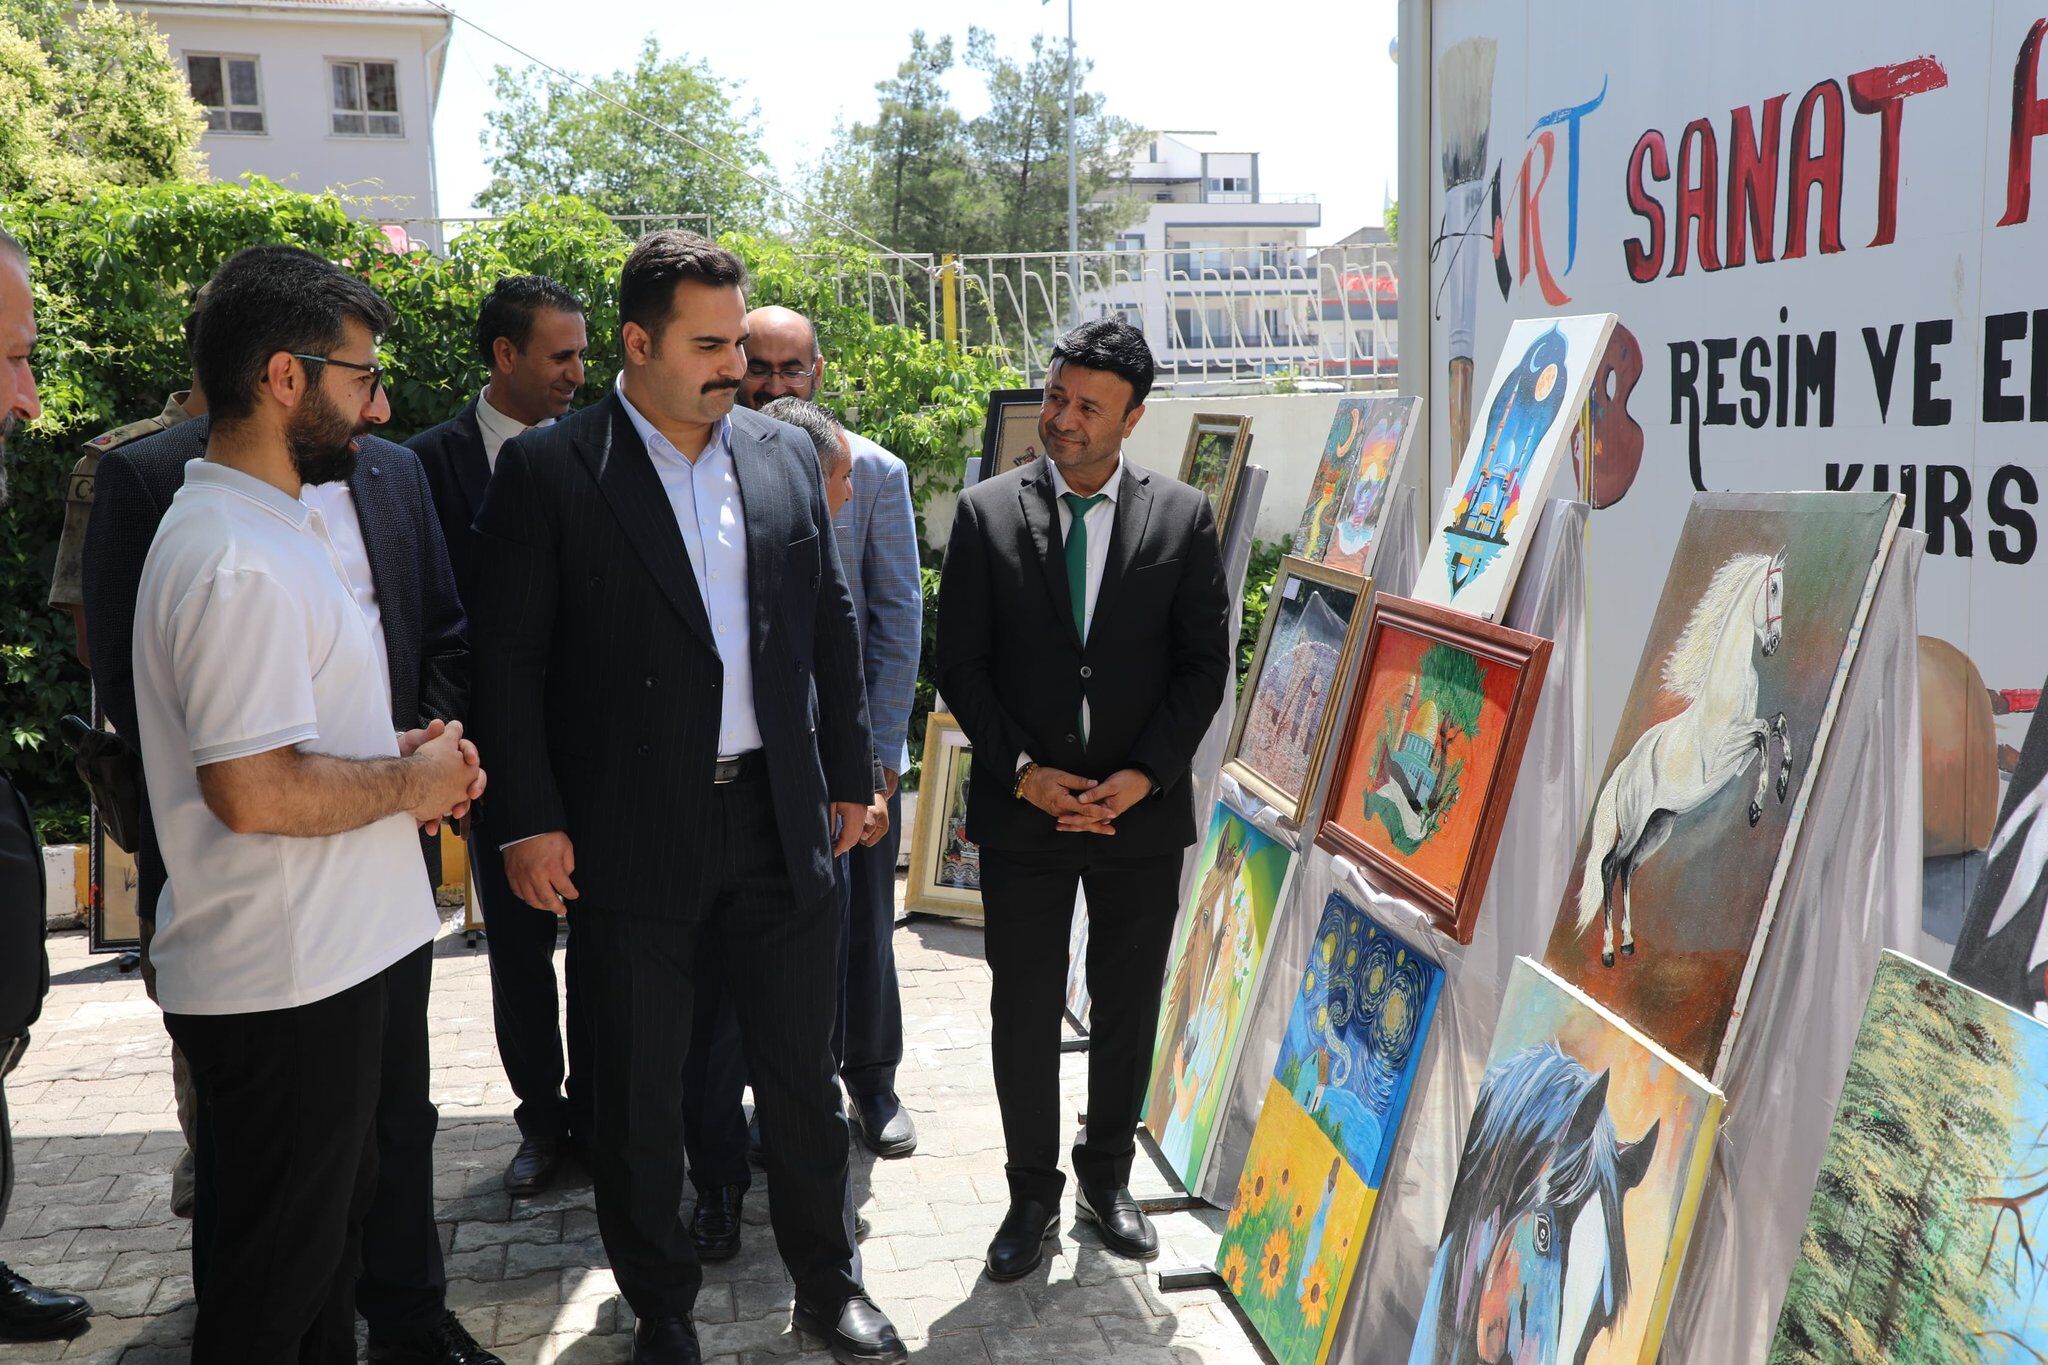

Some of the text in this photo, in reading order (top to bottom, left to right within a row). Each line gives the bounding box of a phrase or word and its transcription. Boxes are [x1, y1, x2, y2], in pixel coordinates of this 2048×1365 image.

[1430, 73, 1608, 321] ART
[1623, 53, 1949, 284] SANAT
[1667, 306, 1836, 491] RESİM
[1861, 319, 1953, 426] VE
